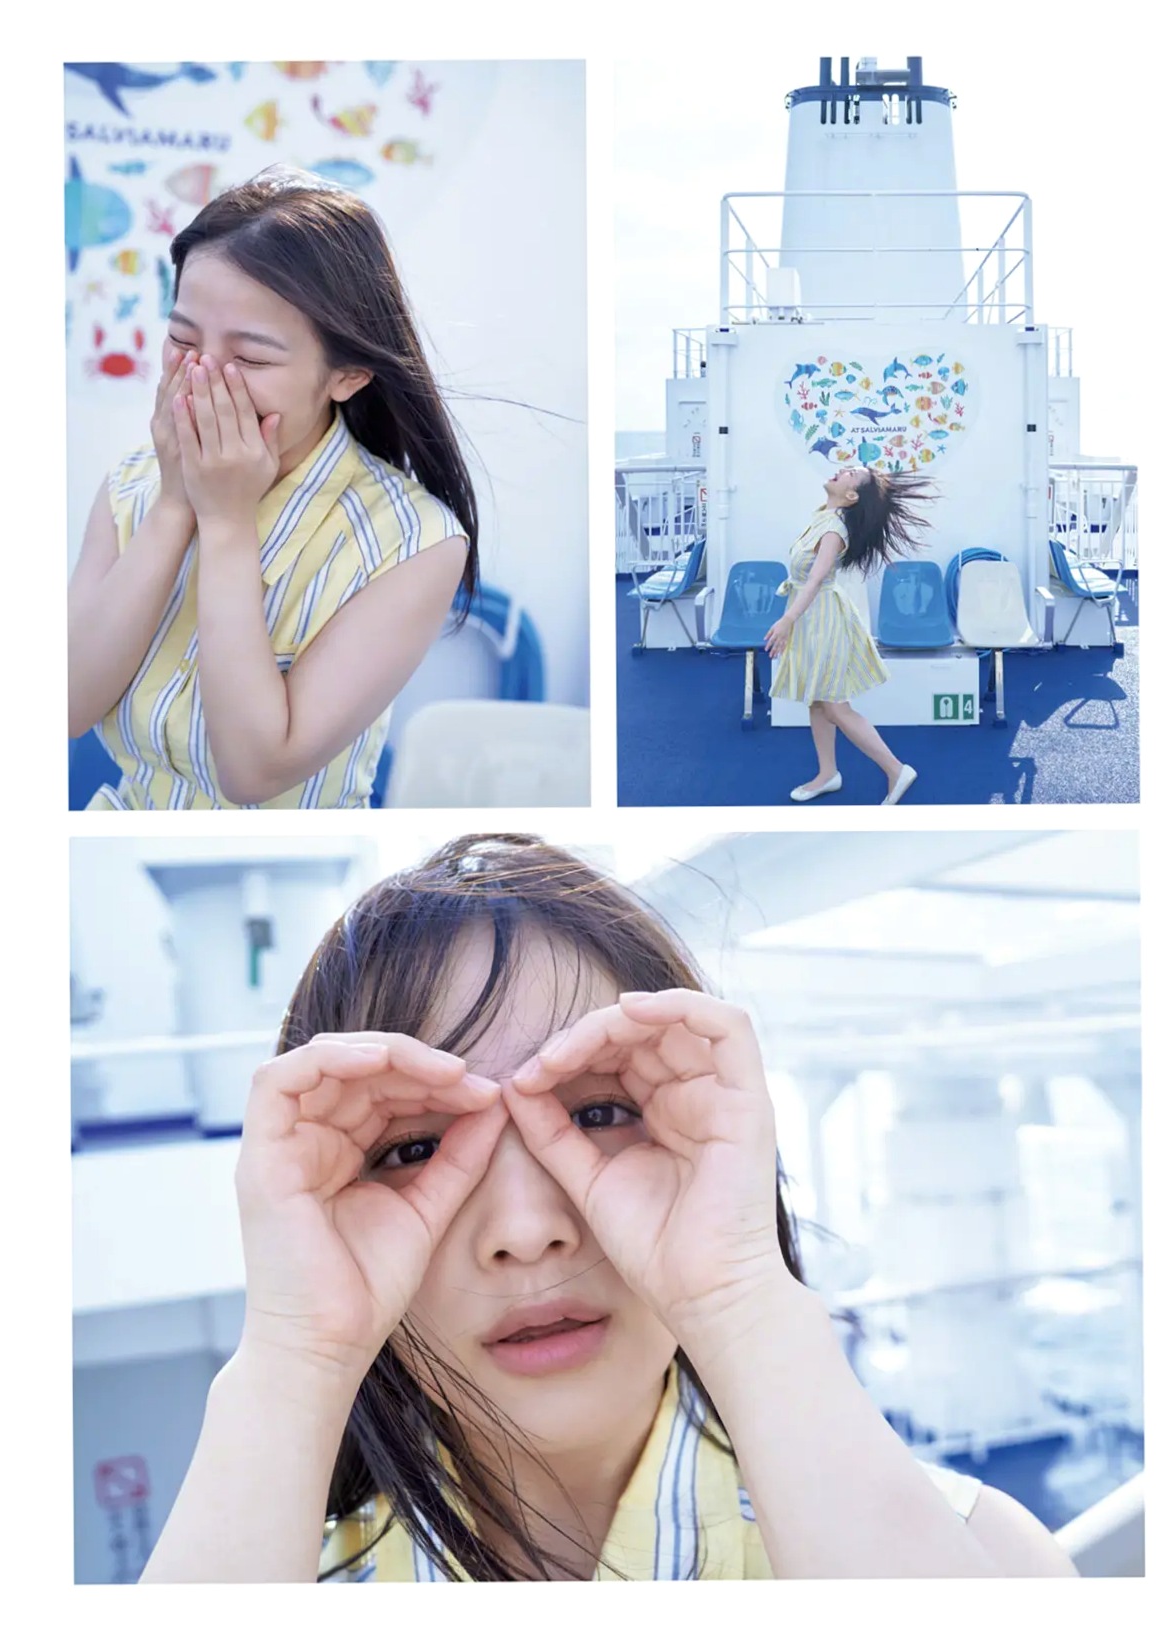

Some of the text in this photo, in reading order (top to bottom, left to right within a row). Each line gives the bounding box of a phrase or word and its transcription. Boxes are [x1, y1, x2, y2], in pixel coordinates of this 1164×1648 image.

[67, 121, 232, 152] SALVIAMARU
[861, 426, 907, 434] SALVIAMARU
[964, 699, 973, 715] 4
